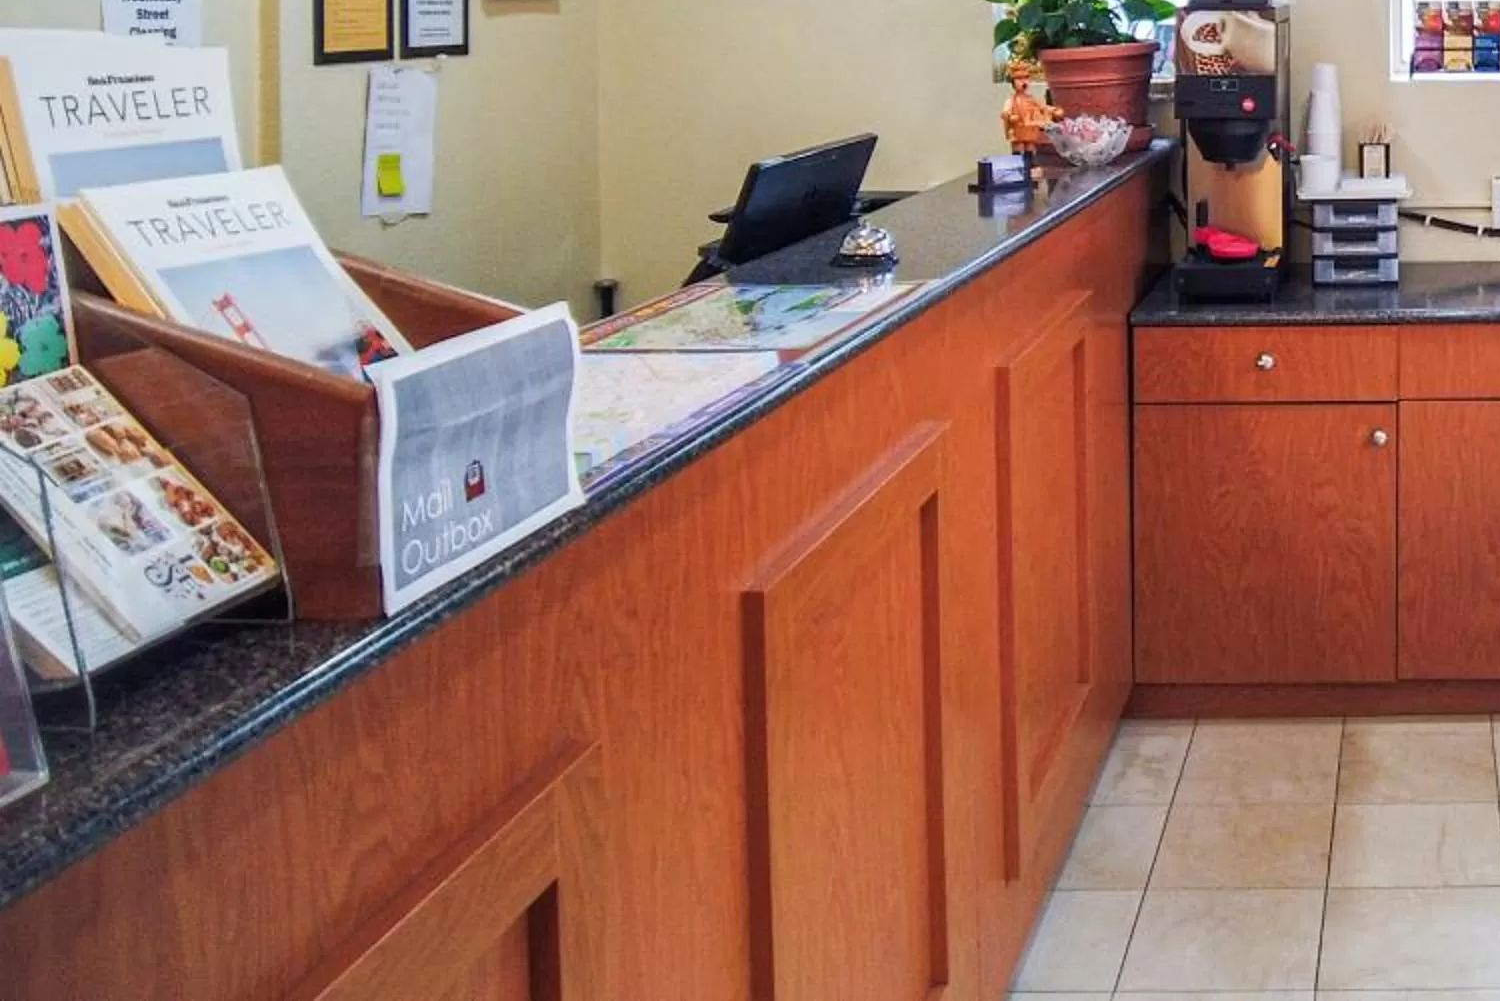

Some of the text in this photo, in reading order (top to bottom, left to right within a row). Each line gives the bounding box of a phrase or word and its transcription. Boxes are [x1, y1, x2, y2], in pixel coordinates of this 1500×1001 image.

[136, 7, 169, 20] Street
[39, 85, 212, 128] TRAVELER
[126, 201, 293, 247] TRAVELER
[401, 478, 453, 532] Mail
[402, 508, 494, 575] Outbox
